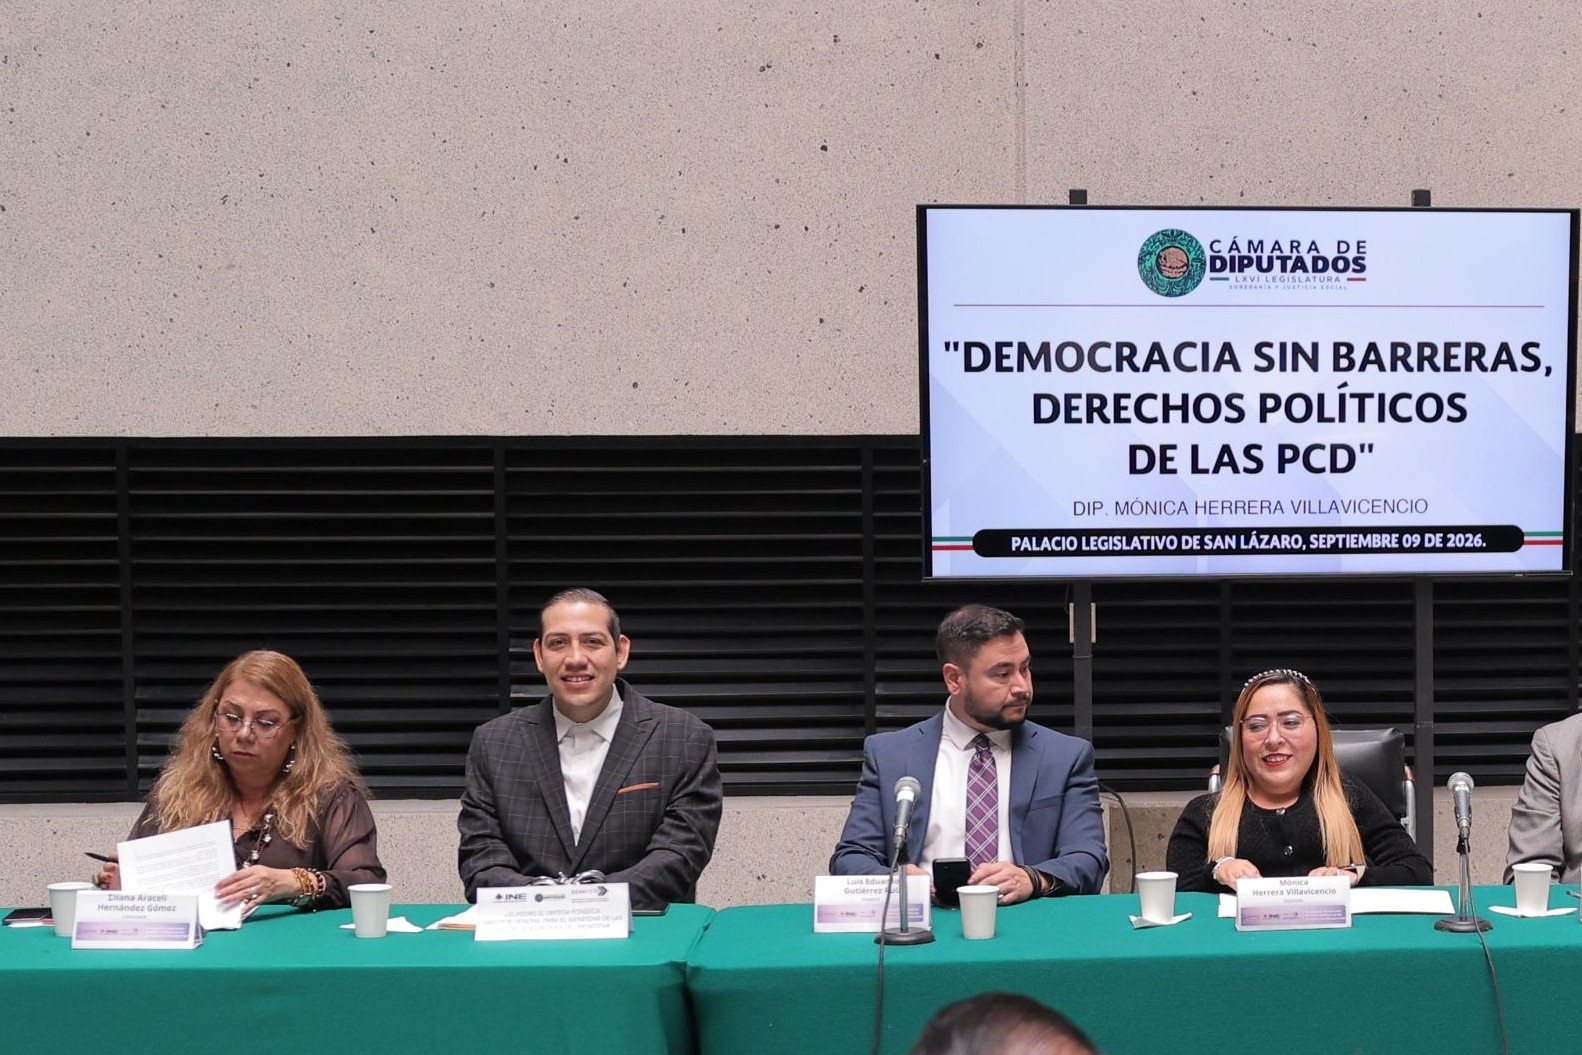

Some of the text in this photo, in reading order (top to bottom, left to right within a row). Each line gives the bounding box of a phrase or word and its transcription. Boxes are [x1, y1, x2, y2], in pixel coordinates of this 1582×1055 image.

[1209, 235, 1368, 255] CÁMARA DE
[1209, 255, 1368, 274] DIPUTADOS
[1234, 275, 1342, 284] LXVI LEGISLATURA
[943, 340, 1554, 378] "DEMOCRACIA SIN BARRERAS,
[1033, 381, 1468, 425] DERECHOS POLÍTICOS
[1128, 443, 1375, 475] DE LAS PCD"
[1073, 497, 1429, 517] DIP. MÓNICA HERRERA VILLAVICENCIO
[1011, 530, 1487, 551] PALACIO LEGISLATIVO DE SAN LÁZARO, SEPTIEMBRE 09 DE 2026.
[1252, 887, 1337, 897] Herrera Villavicencio
[97, 904, 177, 913] Hernández Gómez
